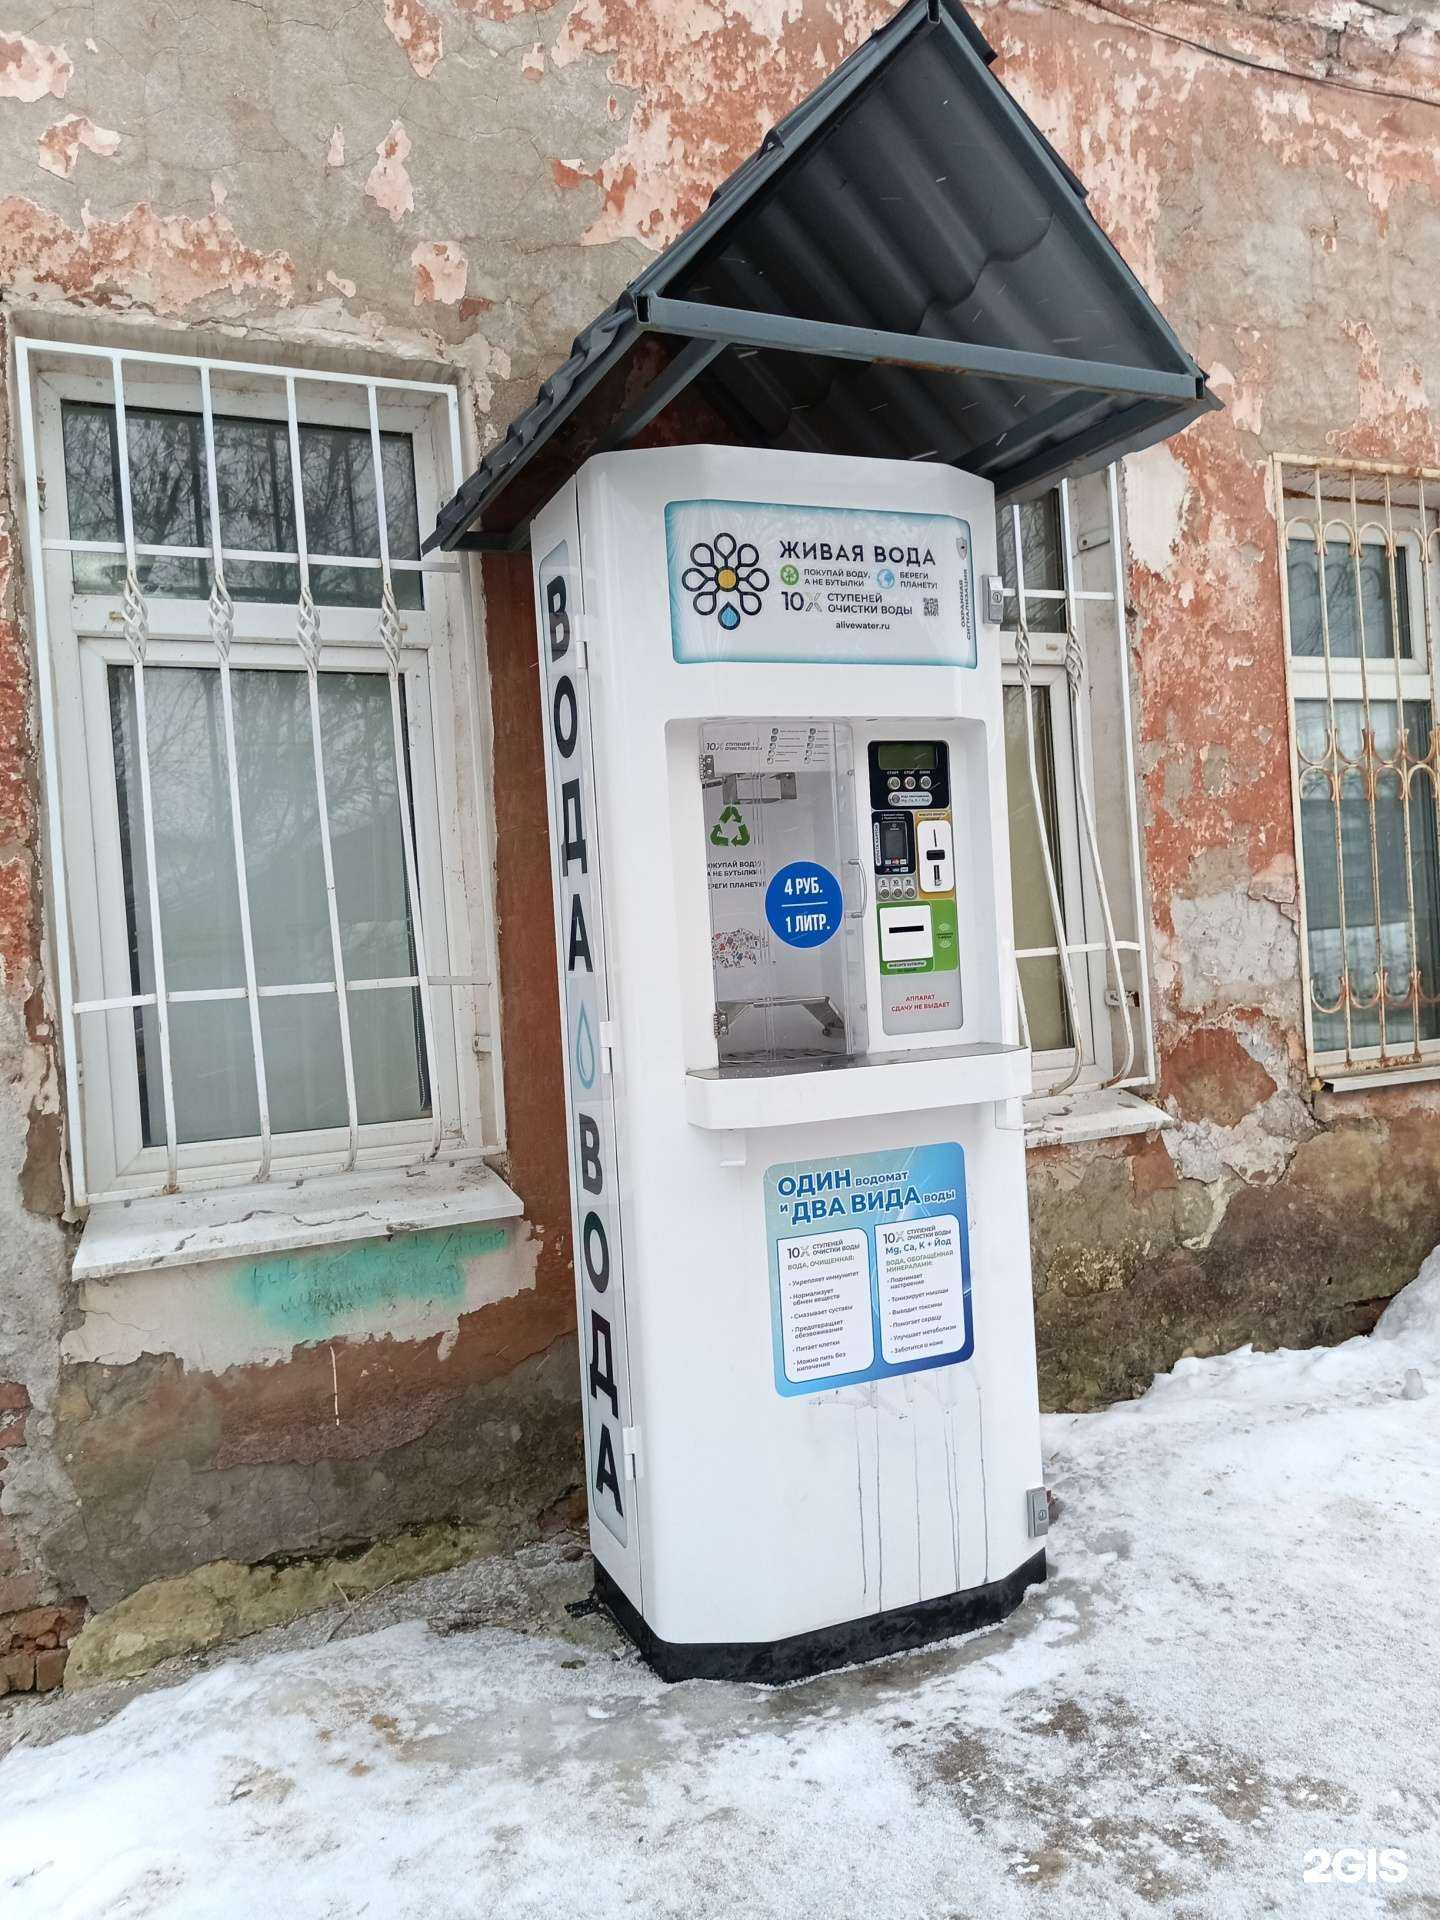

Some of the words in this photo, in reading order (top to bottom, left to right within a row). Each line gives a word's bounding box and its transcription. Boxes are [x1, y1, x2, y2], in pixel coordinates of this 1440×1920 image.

[779, 540, 864, 562] ЖИВАЯ
[874, 545, 936, 567] ВОДА
[804, 568, 844, 577] ПОКУПАЙ
[846, 570, 871, 580] ВОДУ,
[899, 571, 929, 580] БЕРЕГИ
[812, 578, 823, 586] НЕ
[825, 579, 865, 588] БУТЫЛКИ
[900, 580, 938, 590] ПЛАНЕТУ!
[827, 593, 882, 603] СТУПЕНЕЙ
[958, 579, 967, 628] ОХРАННАЯ
[828, 604, 878, 614] ОЧИСТКИ
[881, 605, 913, 616] ВОДЫ
[963, 569, 972, 640] СИГНАЛИЗАЦИЯ
[835, 620, 890, 631] alivewater.ru
[546, 575, 593, 973] ВОДА
[784, 879, 793, 895] 4
[796, 877, 823, 895] РУБ.
[785, 916, 792, 933] 1
[795, 914, 830, 932] ЛИТР.
[905, 994, 935, 1002] АППАРАТ
[891, 1004, 912, 1012] СДАЧУ
[924, 1001, 950, 1009] ВЫДАЕТ
[777, 1168, 851, 1198] ОДИН
[855, 1171, 909, 1187] водомат
[791, 1197, 846, 1225] ДВА
[851, 1186, 921, 1214] ВИДА
[924, 1189, 955, 1203] воды
[907, 1225, 936, 1235] СТУПЕНЕЙ
[907, 1232, 934, 1241] ОЧИСТКИ
[935, 1229, 951, 1237] ВОДЫ
[812, 1239, 843, 1250] СТУПЕНЕЙ
[812, 1246, 841, 1255] ОЧИСТКИ
[842, 1244, 860, 1252] ВОДЫ
[885, 1246, 902, 1256] Mg,
[904, 1244, 917, 1252] Ca,
[935, 1237, 951, 1247] Йод
[787, 1262, 809, 1271] ВОДА,
[792, 1276, 825, 1287] Укрепляет
[826, 1271, 859, 1280] иммунитет
[890, 1274, 923, 1283] Поднимает
[793, 1288, 834, 1300] Нормализует
[793, 1298, 813, 1306] обмен
[814, 1294, 840, 1303] веществ
[892, 1292, 925, 1303] Тонизирует
[794, 1309, 828, 1320] Смазывает
[829, 1305, 853, 1314] суставы
[892, 1305, 918, 1315] Выводит
[919, 1302, 943, 1310] токсины
[579, 1113, 623, 1517] ВОДА
[796, 1344, 818, 1352] Питает
[819, 1340, 840, 1349] клетки
[894, 1344, 924, 1354] Заботится
[797, 1357, 819, 1366] Можно
[820, 1354, 834, 1362] пить
